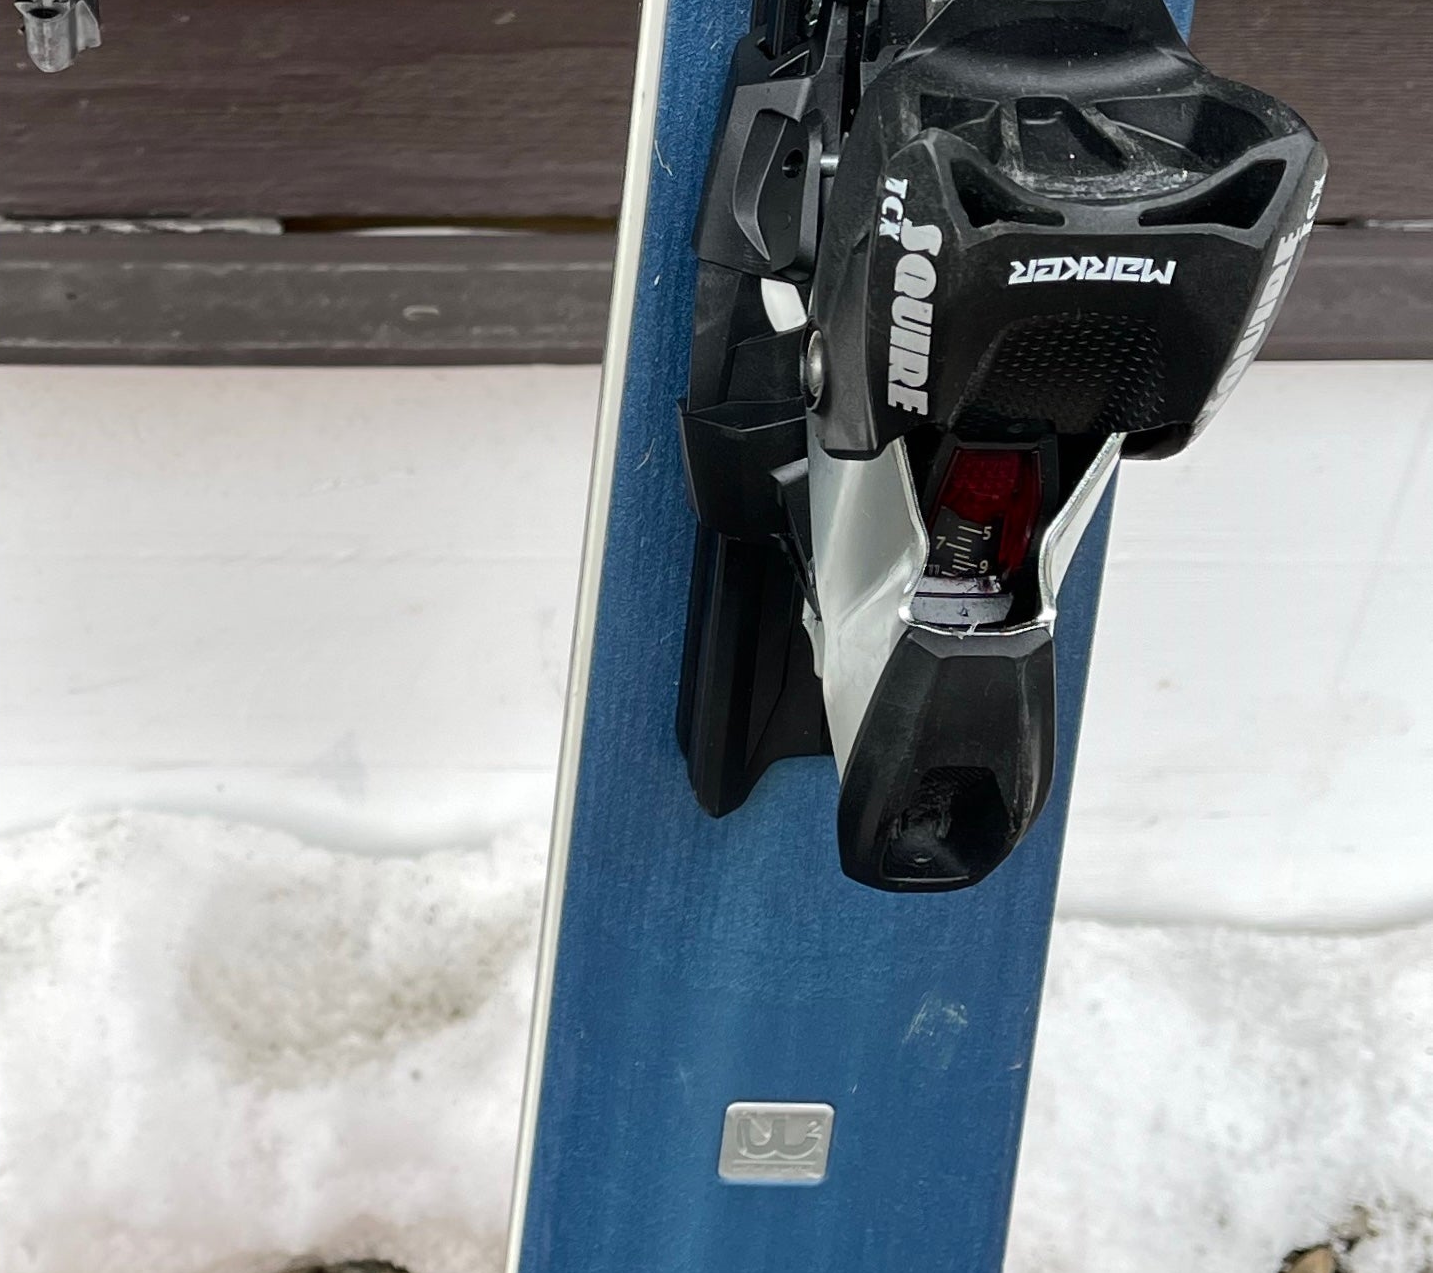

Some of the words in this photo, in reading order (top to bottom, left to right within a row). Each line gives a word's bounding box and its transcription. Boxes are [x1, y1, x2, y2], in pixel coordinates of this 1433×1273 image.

[1008, 256, 1177, 286] MARKER
[886, 217, 944, 416] SQUIRE
[982, 526, 993, 541] 5
[936, 535, 947, 550] 7
[978, 559, 989, 574] 9
